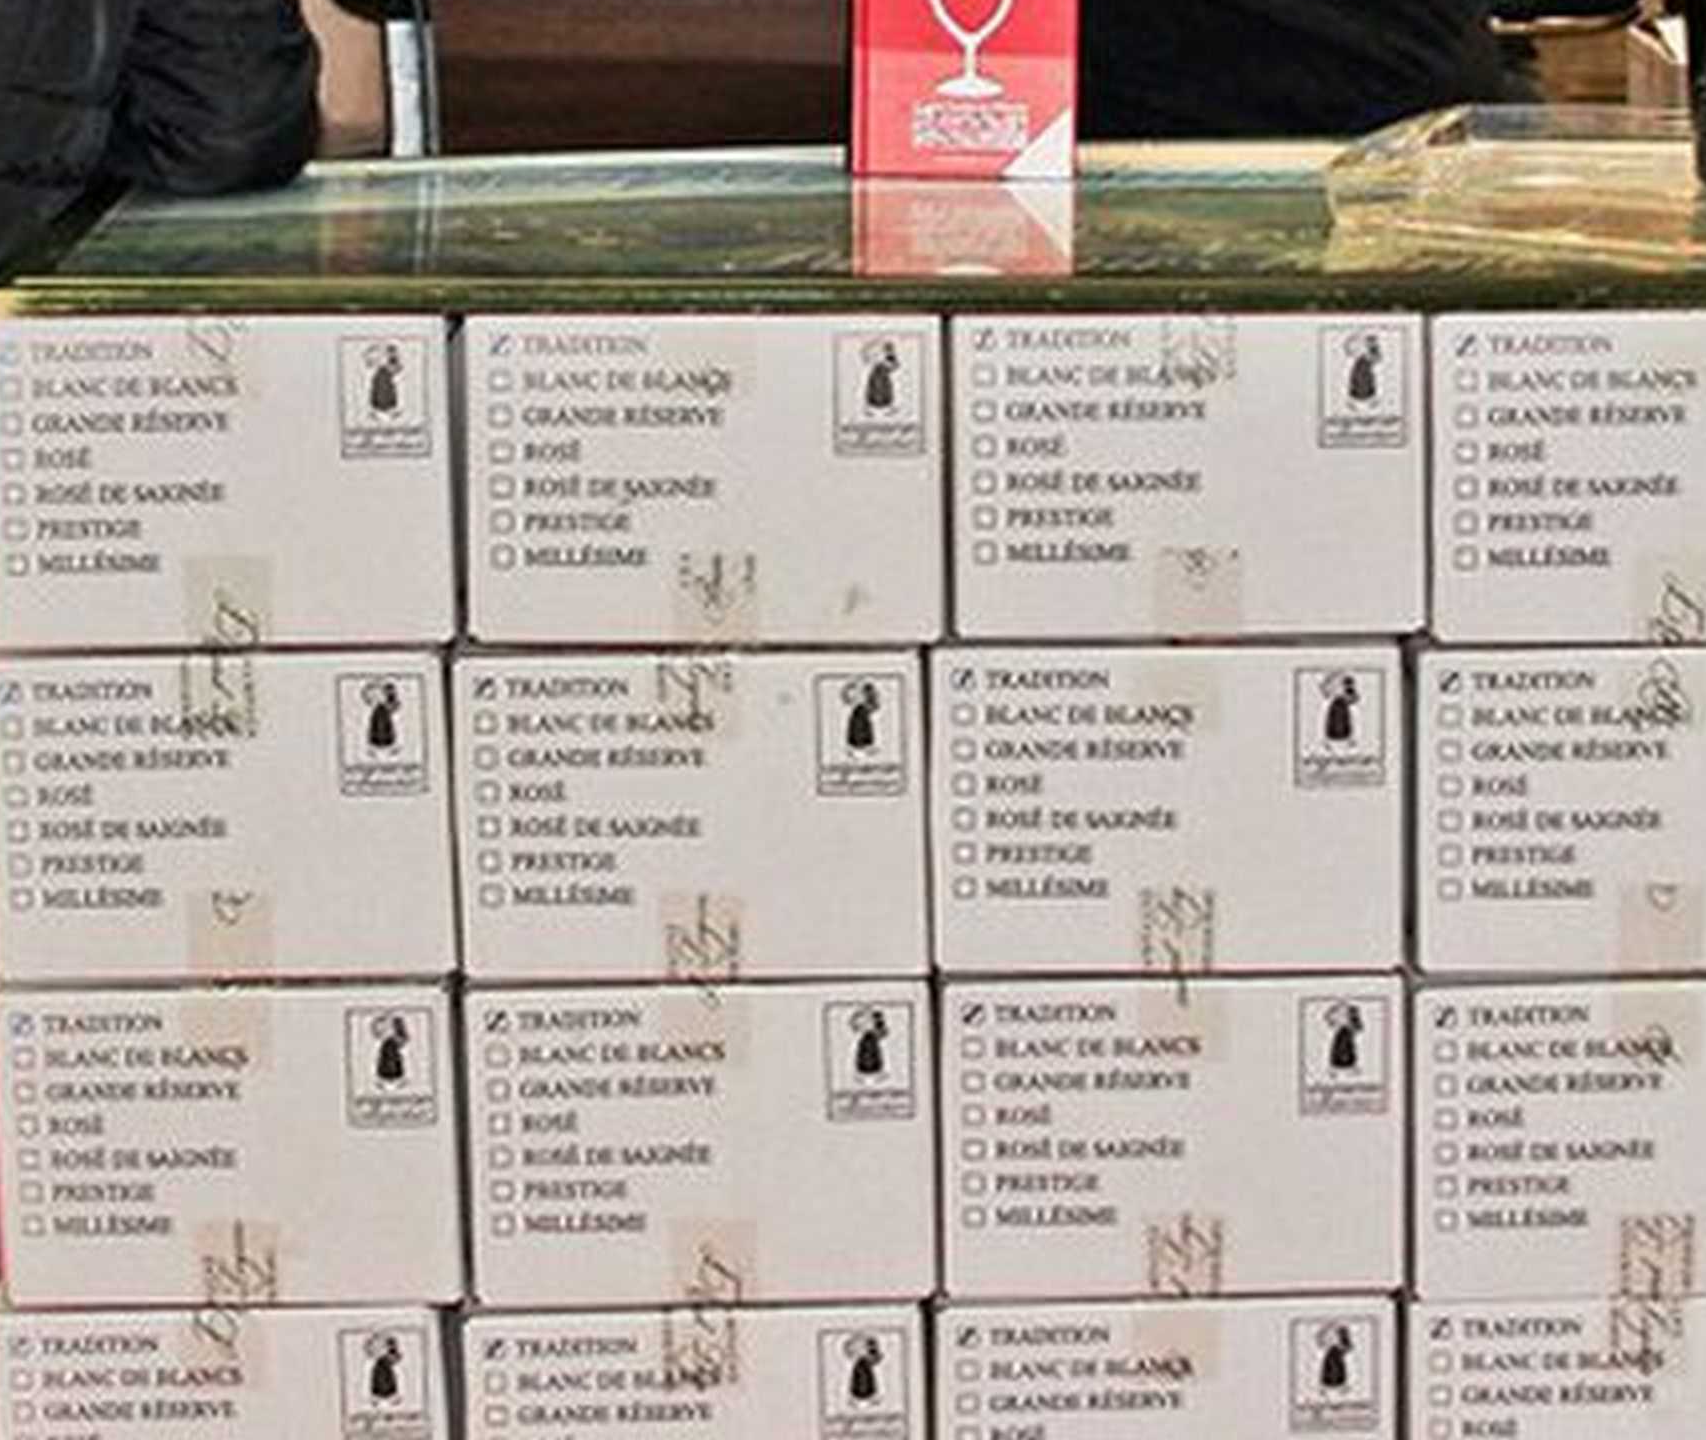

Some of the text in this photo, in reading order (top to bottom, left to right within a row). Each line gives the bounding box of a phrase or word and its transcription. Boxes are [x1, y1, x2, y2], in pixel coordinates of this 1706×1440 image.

[520, 333, 650, 358] TRADITION
[1005, 327, 1132, 352] TRADITION
[1485, 333, 1614, 357] TRADITION
[521, 369, 600, 393] BLANC
[606, 369, 636, 393] DE
[521, 405, 617, 428] GRANDE
[1004, 400, 1101, 423] GRANDE
[1486, 405, 1583, 428] GRANDE
[587, 476, 618, 500] DE
[523, 511, 633, 534] PRESTIGE
[1005, 506, 1115, 529] PRESTIGE
[1487, 511, 1595, 534] PRESTIGE
[505, 676, 630, 700] TRADITION
[984, 668, 1111, 691] TRADITION
[1470, 670, 1597, 692] TRADITION
[30, 680, 154, 703] TRADITION
[505, 712, 582, 736] BLANC
[588, 712, 619, 735] DE
[984, 703, 1062, 727] BLANC
[1067, 703, 1098, 727] DE
[33, 748, 232, 773] GRANDE RÉSERVE
[506, 746, 707, 770] GRANDE RÉSERVE
[984, 738, 1186, 761] GRANDE RÉSERVE
[1470, 739, 1671, 763] GRANDE RÉSERVE
[36, 784, 96, 808] ROSÉ
[508, 781, 568, 804] ROSÉ
[984, 773, 1045, 797] ROSÉ
[1471, 774, 1531, 798] ROSÉ
[509, 815, 702, 839] ROSÉ DE SAIGNÉE
[985, 808, 1179, 831] ROSÉ DE SAIGNÉE
[1471, 809, 1663, 833] ROSÉ DE SAIGNÉE
[40, 852, 146, 876] PRESTIGE
[510, 850, 618, 874] PRESTIGE
[985, 842, 1094, 865] PRESTIGE
[1470, 843, 1578, 867] PRESTIGE
[41, 887, 165, 910] MILLÉSIME
[512, 885, 637, 907] MILLÉSIME
[985, 877, 1110, 900] MILLÉSIME
[1471, 878, 1596, 901] MILLÉSIME
[41, 1012, 165, 1035] TRADITION
[516, 1008, 643, 1032] TRADITION
[993, 1002, 1119, 1025] TRADITION
[1465, 1004, 1591, 1027] TRADITION
[517, 1044, 596, 1067] BLANC
[600, 1042, 631, 1065] DE
[993, 1036, 1070, 1060] BLANC
[1075, 1036, 1107, 1059] DE
[44, 1080, 241, 1103] GRANDE RÉSERVE
[518, 1076, 718, 1100] GRANDE RÉSERVE
[993, 1070, 1191, 1093] GRANDE RÉSERVE
[1465, 1071, 1664, 1095] GRANDE RÉSERVE
[47, 1114, 106, 1138] ROSÉ
[520, 1112, 579, 1135] ROSÉ
[994, 1105, 1054, 1127] ROSÉ
[1466, 1107, 1526, 1130] ROSÉ
[521, 1144, 713, 1168] ROSÉ DE SAIGNÉE
[994, 1138, 1186, 1162] ROSÉ DE SAIGNÉE
[1466, 1140, 1656, 1164] ROSÉ DE SAIGNÉE
[51, 1181, 157, 1204] PRESTIGE
[522, 1178, 629, 1202] PRESTIGE
[995, 1172, 1101, 1194] PRESTIGE
[1466, 1174, 1574, 1197] PRESTIGE
[52, 1215, 175, 1238] MILLÉSIME
[523, 1212, 648, 1235] MILLÉSIME
[995, 1205, 1119, 1228] MILLÉSIME
[1466, 1208, 1589, 1230] MILLÉSIME
